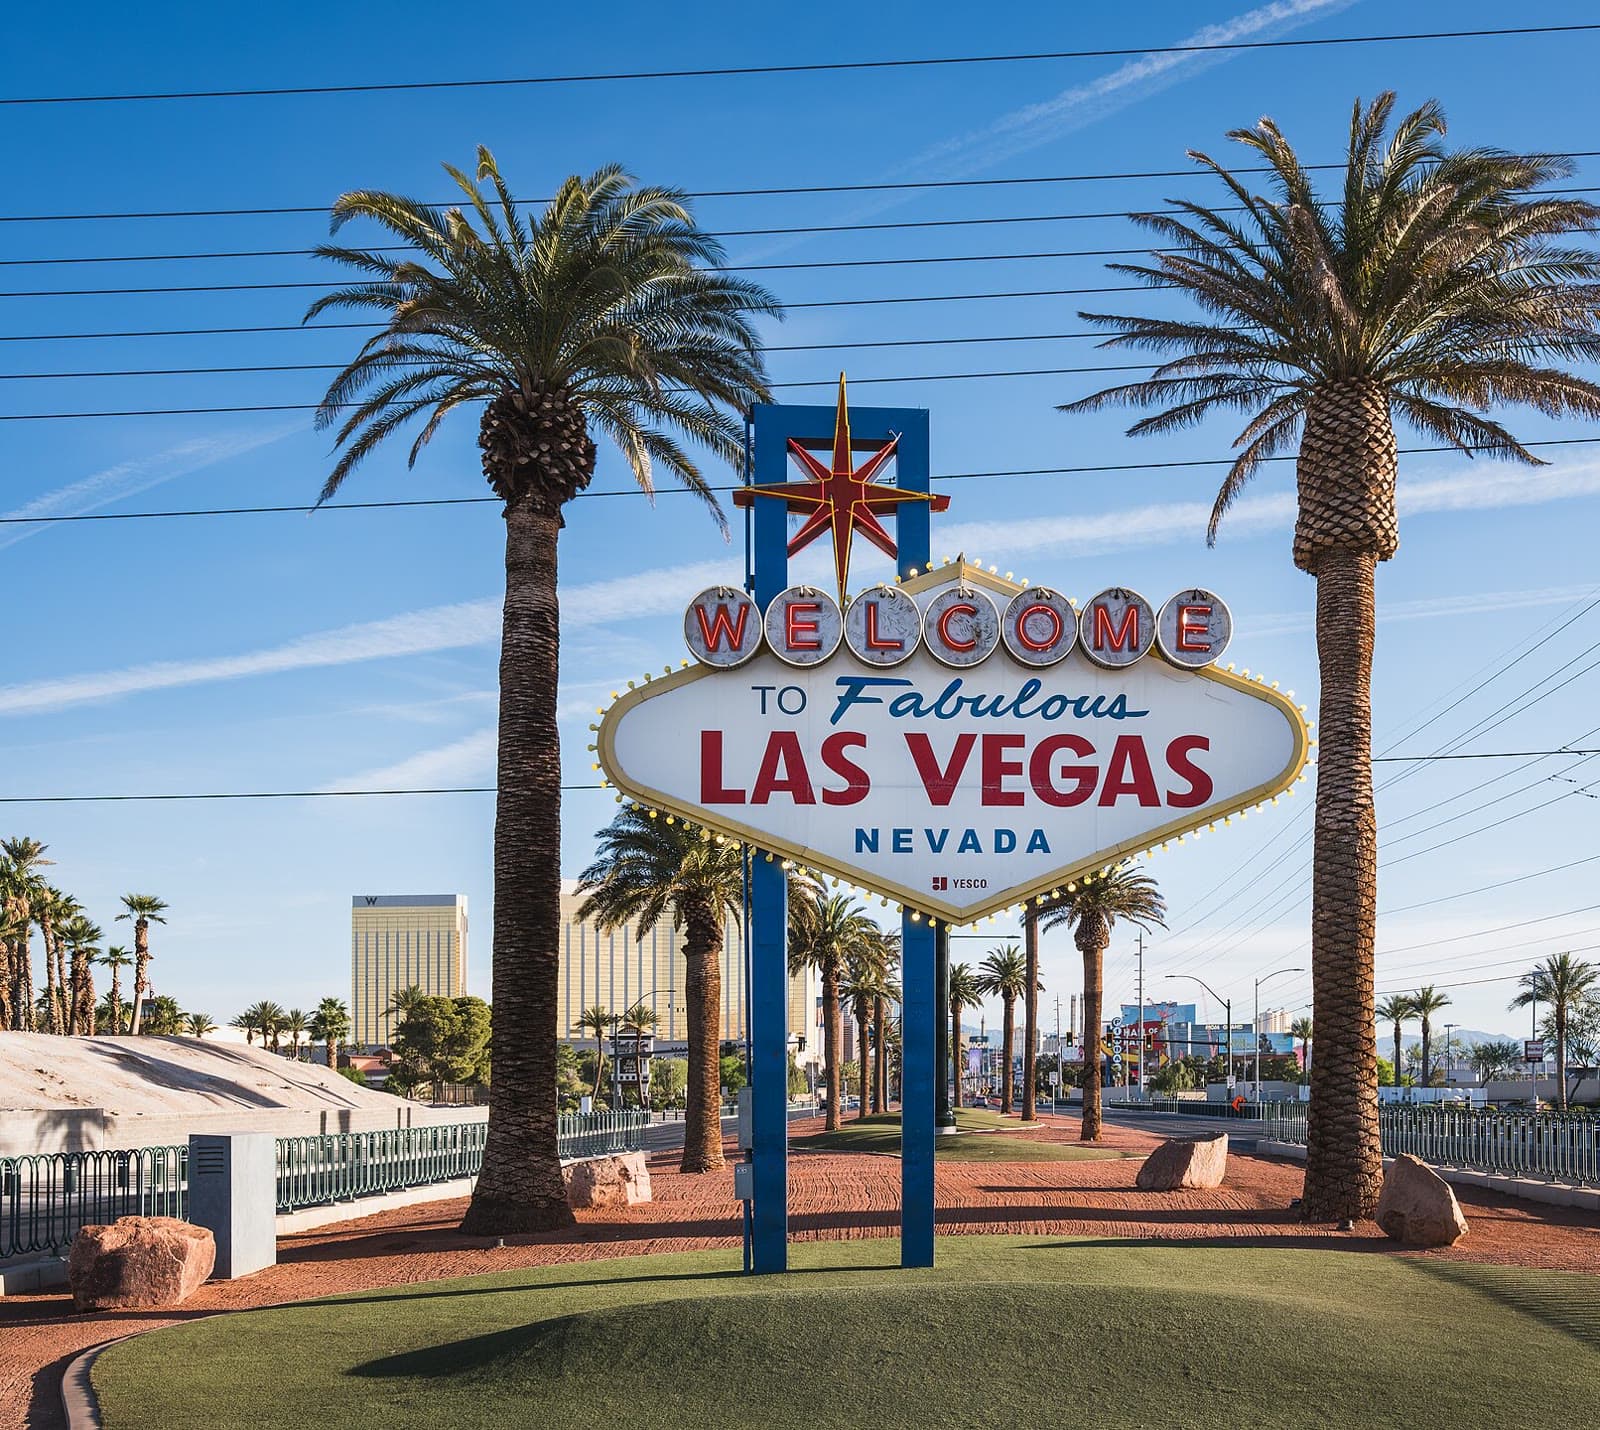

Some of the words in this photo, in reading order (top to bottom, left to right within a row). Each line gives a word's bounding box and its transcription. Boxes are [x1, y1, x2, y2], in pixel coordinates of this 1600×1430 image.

[695, 601, 1212, 653] WELCOME
[751, 685, 808, 715] TO
[829, 675, 1151, 727] Fabulous
[700, 729, 871, 807] LAS
[903, 732, 1214, 809] VEGAS
[854, 827, 1052, 854] NEVADA
[365, 896, 378, 905] W
[952, 878, 988, 889] YESCO
